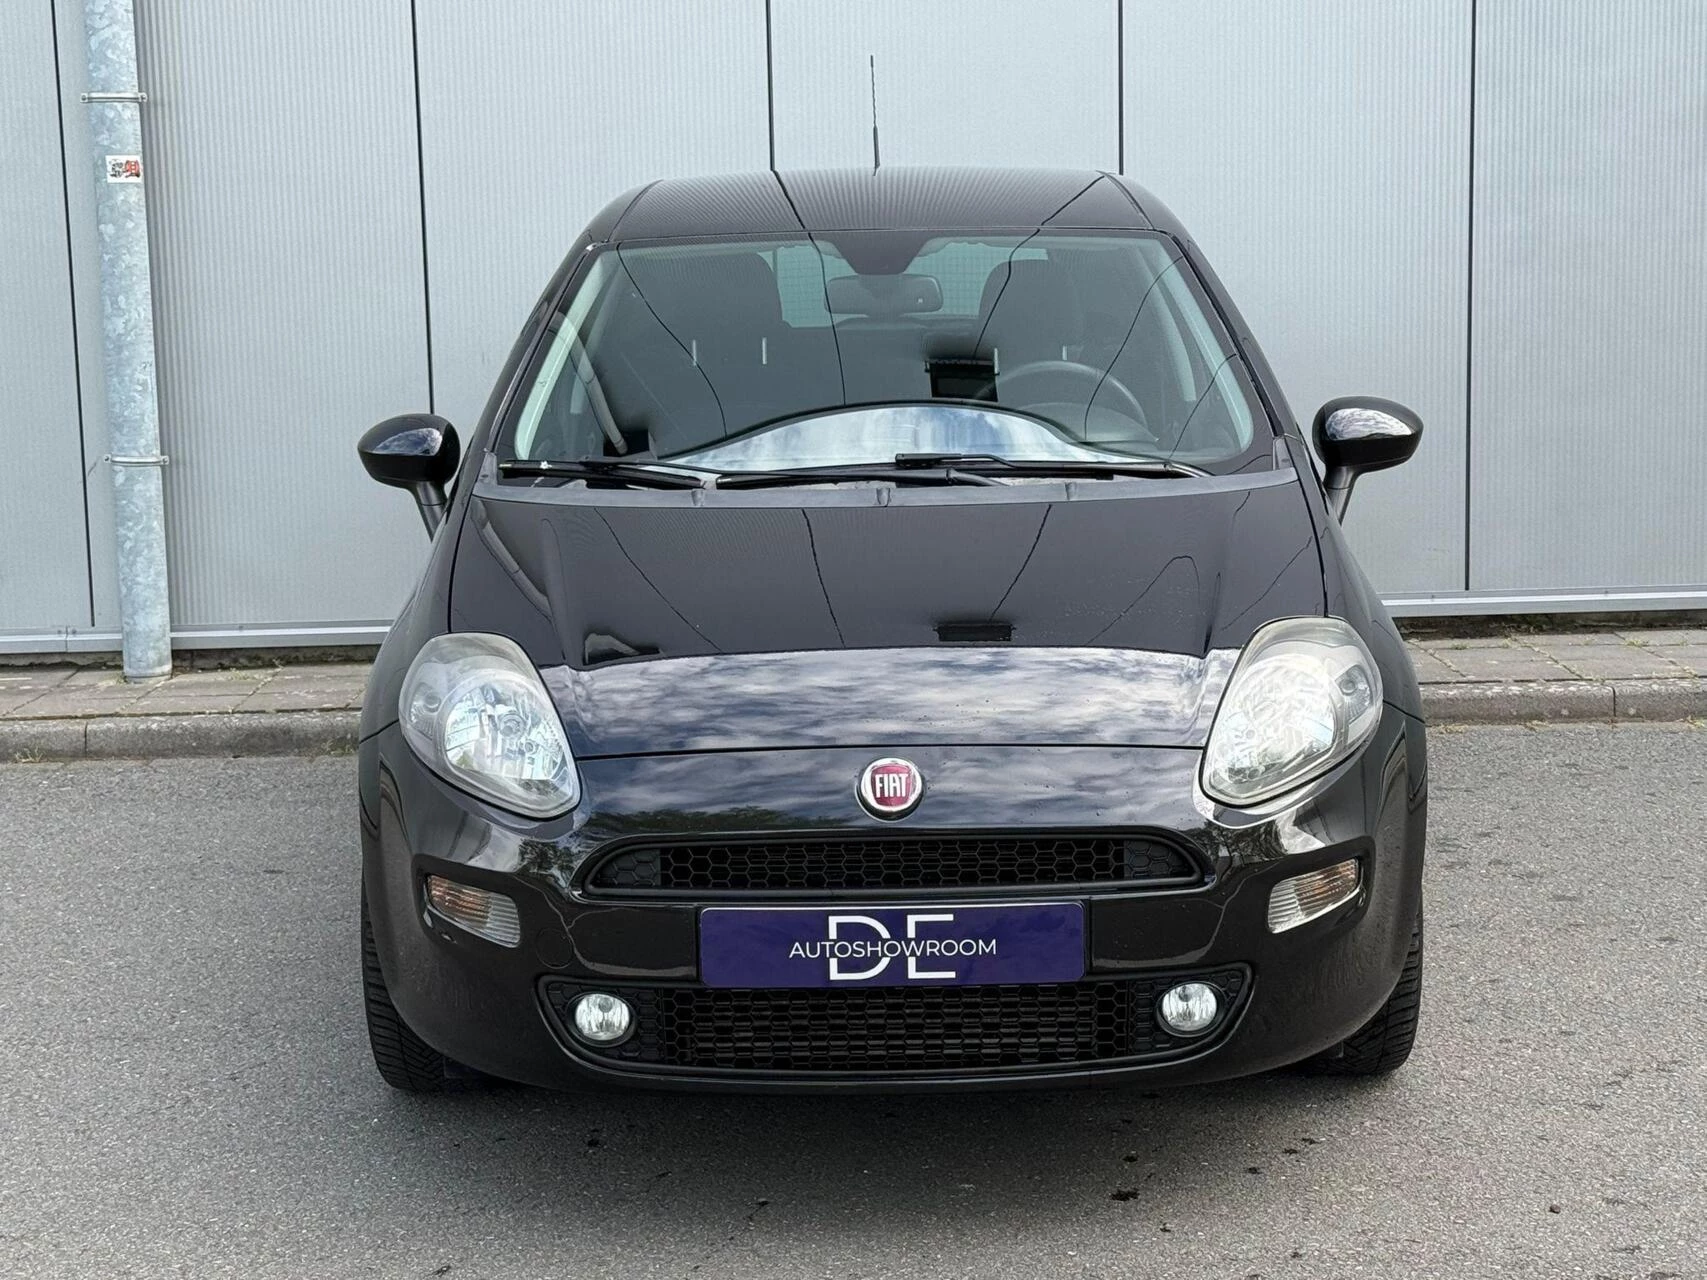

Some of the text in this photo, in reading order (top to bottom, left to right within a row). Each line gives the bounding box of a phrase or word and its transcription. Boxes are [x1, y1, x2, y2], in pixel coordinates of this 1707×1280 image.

[875, 773, 908, 798] FIAT
[788, 938, 997, 959] AUTOSHOWROOM
[828, 913, 956, 981] DE
